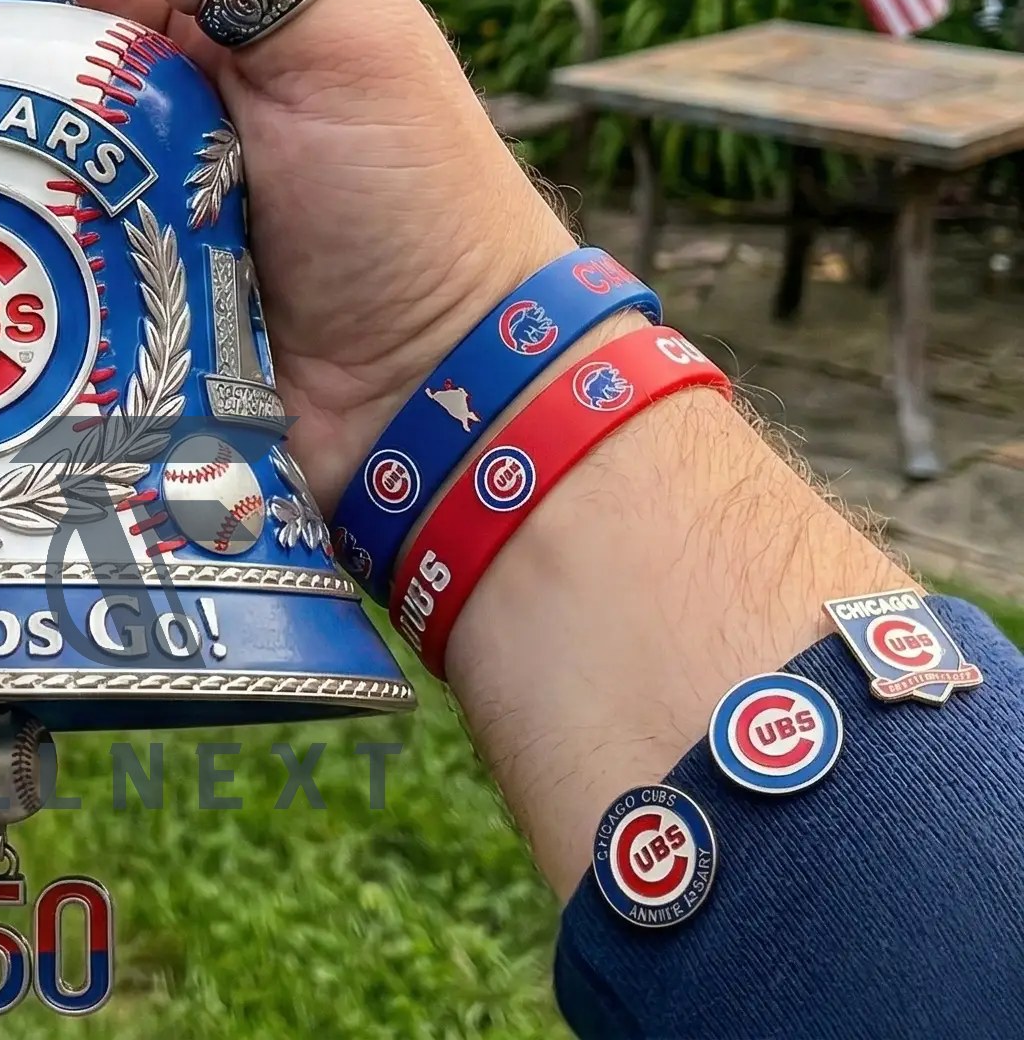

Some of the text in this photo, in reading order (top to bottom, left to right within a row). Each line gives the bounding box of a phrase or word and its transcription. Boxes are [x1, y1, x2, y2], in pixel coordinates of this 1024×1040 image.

[87, 595, 228, 662] Go!
[835, 594, 920, 621] CHICAGO
[735, 695, 816, 768] CUBS
[641, 789, 677, 807] CUBS
[616, 813, 689, 898] CUBS
